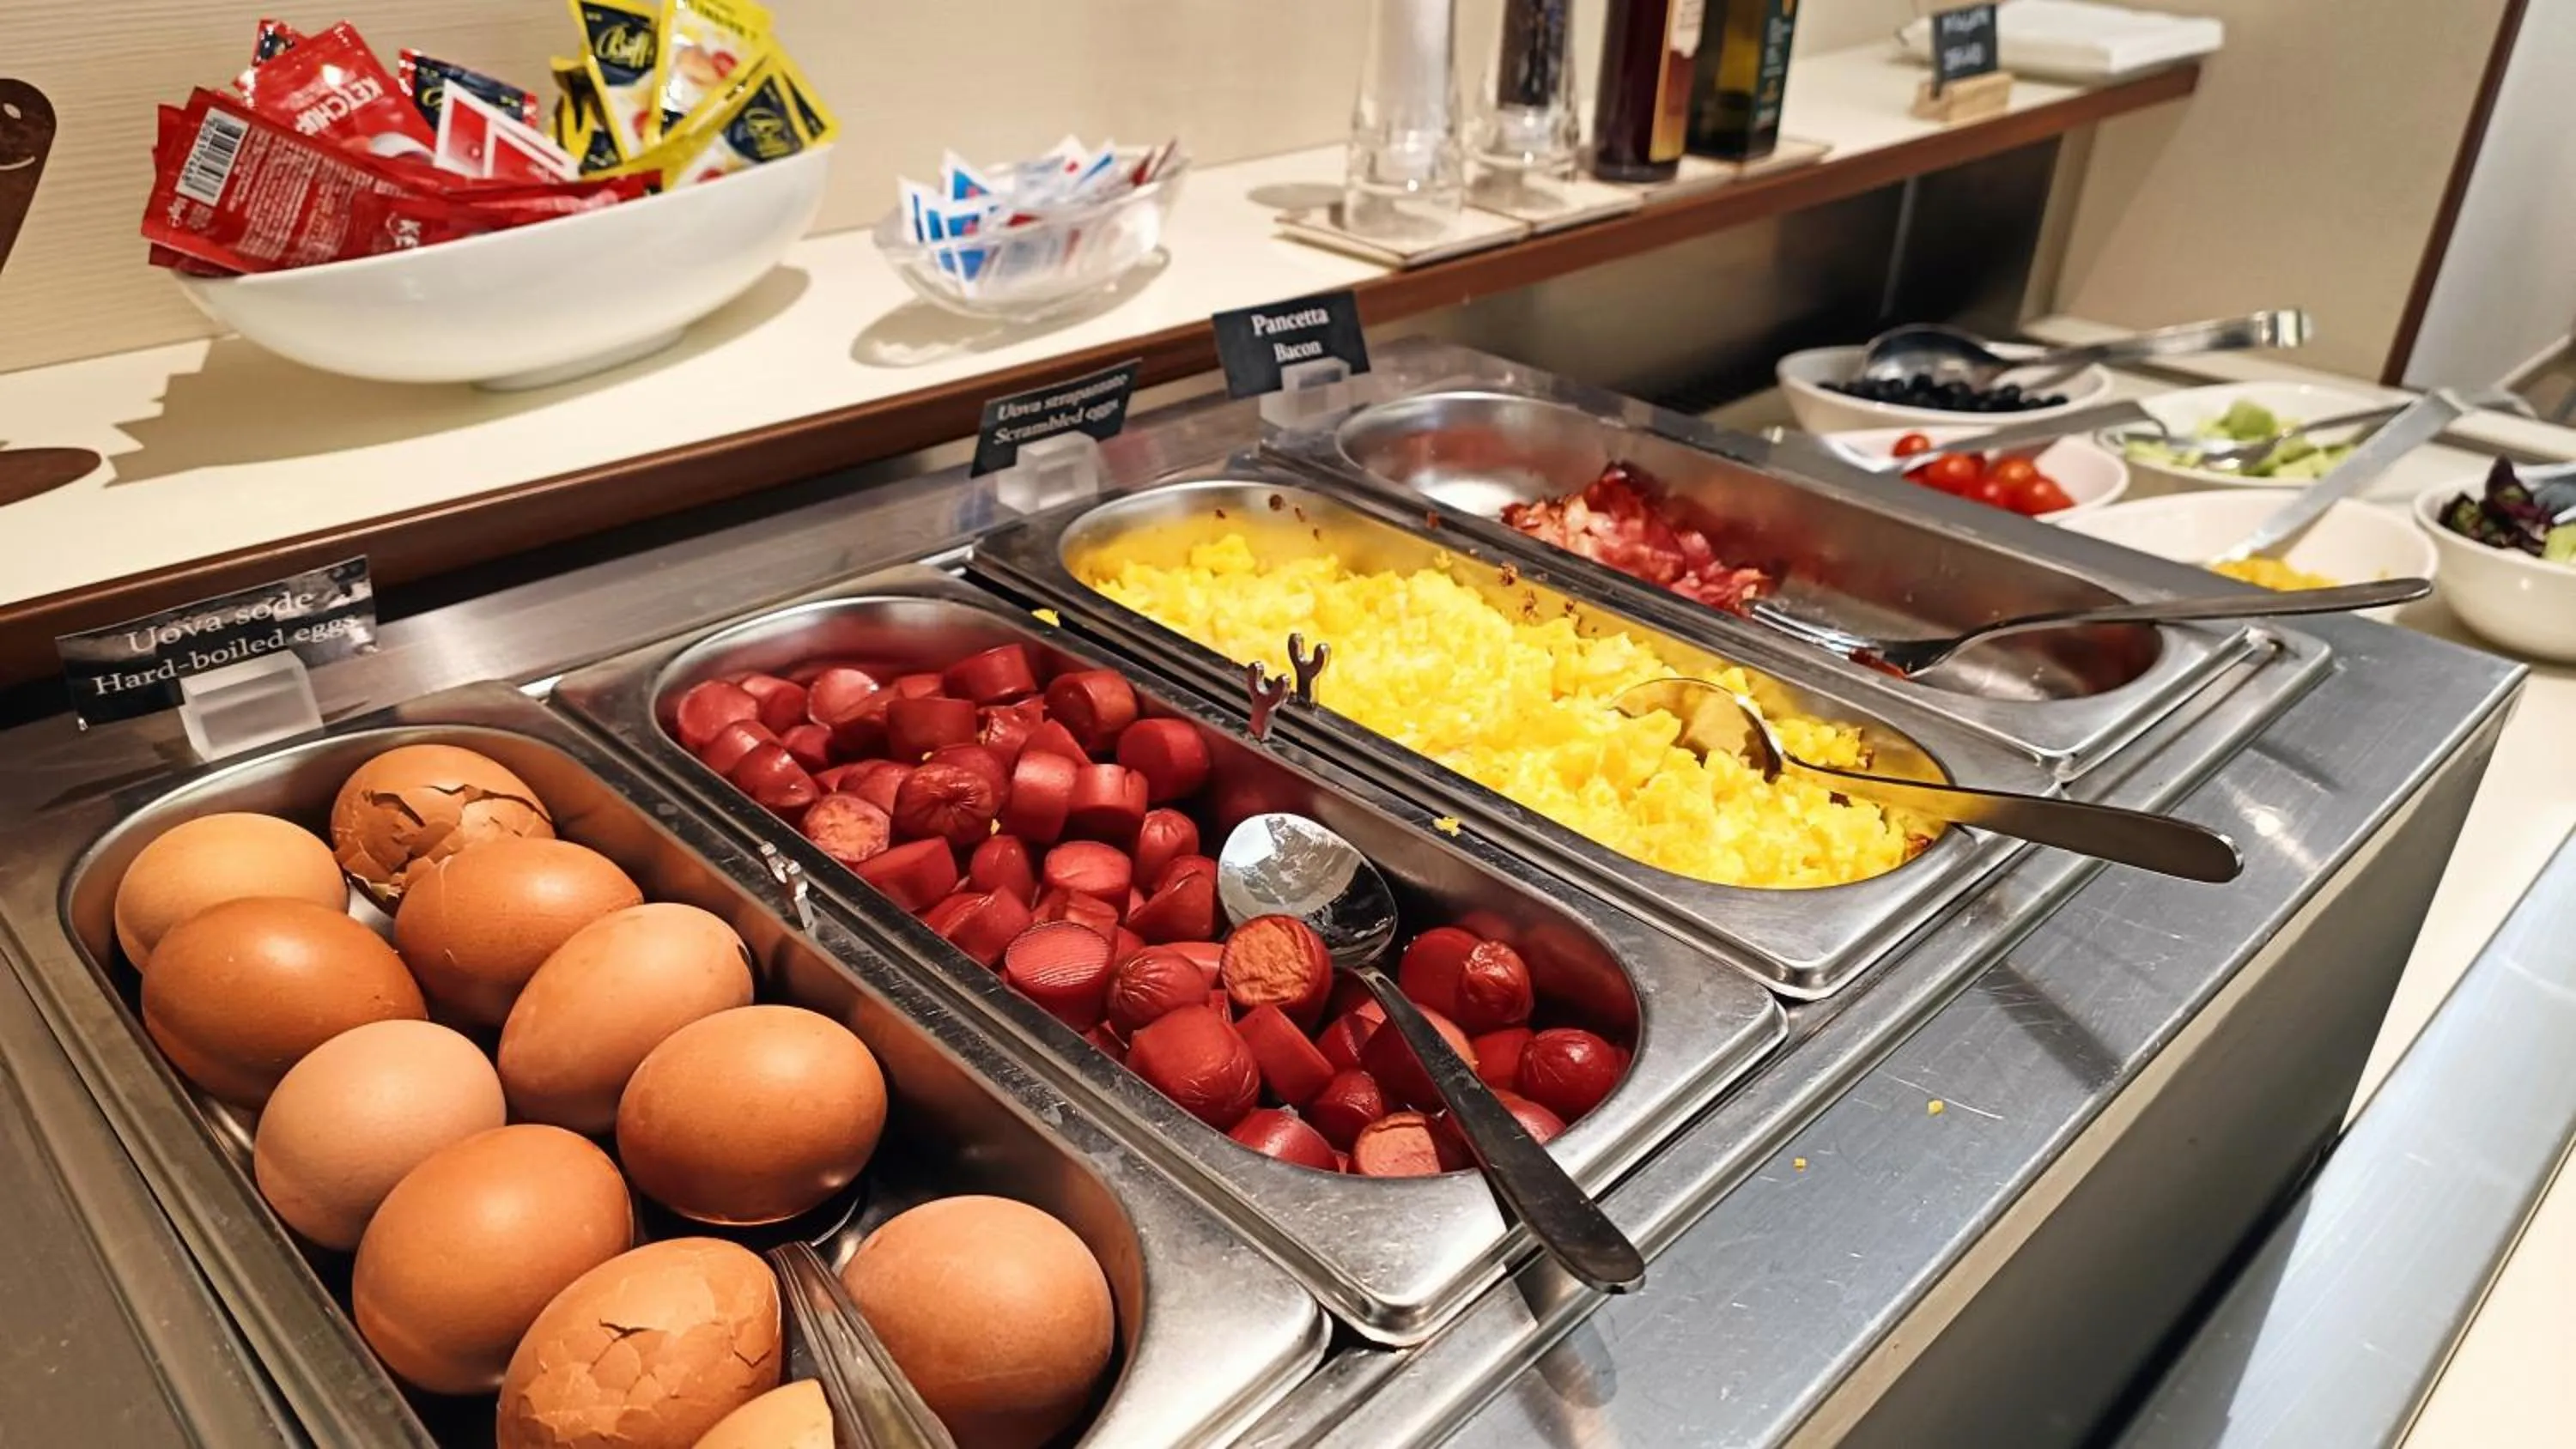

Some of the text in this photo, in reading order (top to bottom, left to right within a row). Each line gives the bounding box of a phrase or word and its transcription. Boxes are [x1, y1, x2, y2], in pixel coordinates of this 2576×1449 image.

[295, 76, 384, 136] KETCHUP
[1251, 308, 1330, 336] Pancetta
[1273, 341, 1322, 362] Bacon
[993, 407, 1084, 445] Scrambled
[998, 401, 1042, 421] Uova
[126, 590, 316, 655] Uova sode
[93, 615, 358, 696] Hard-boiled eggs
